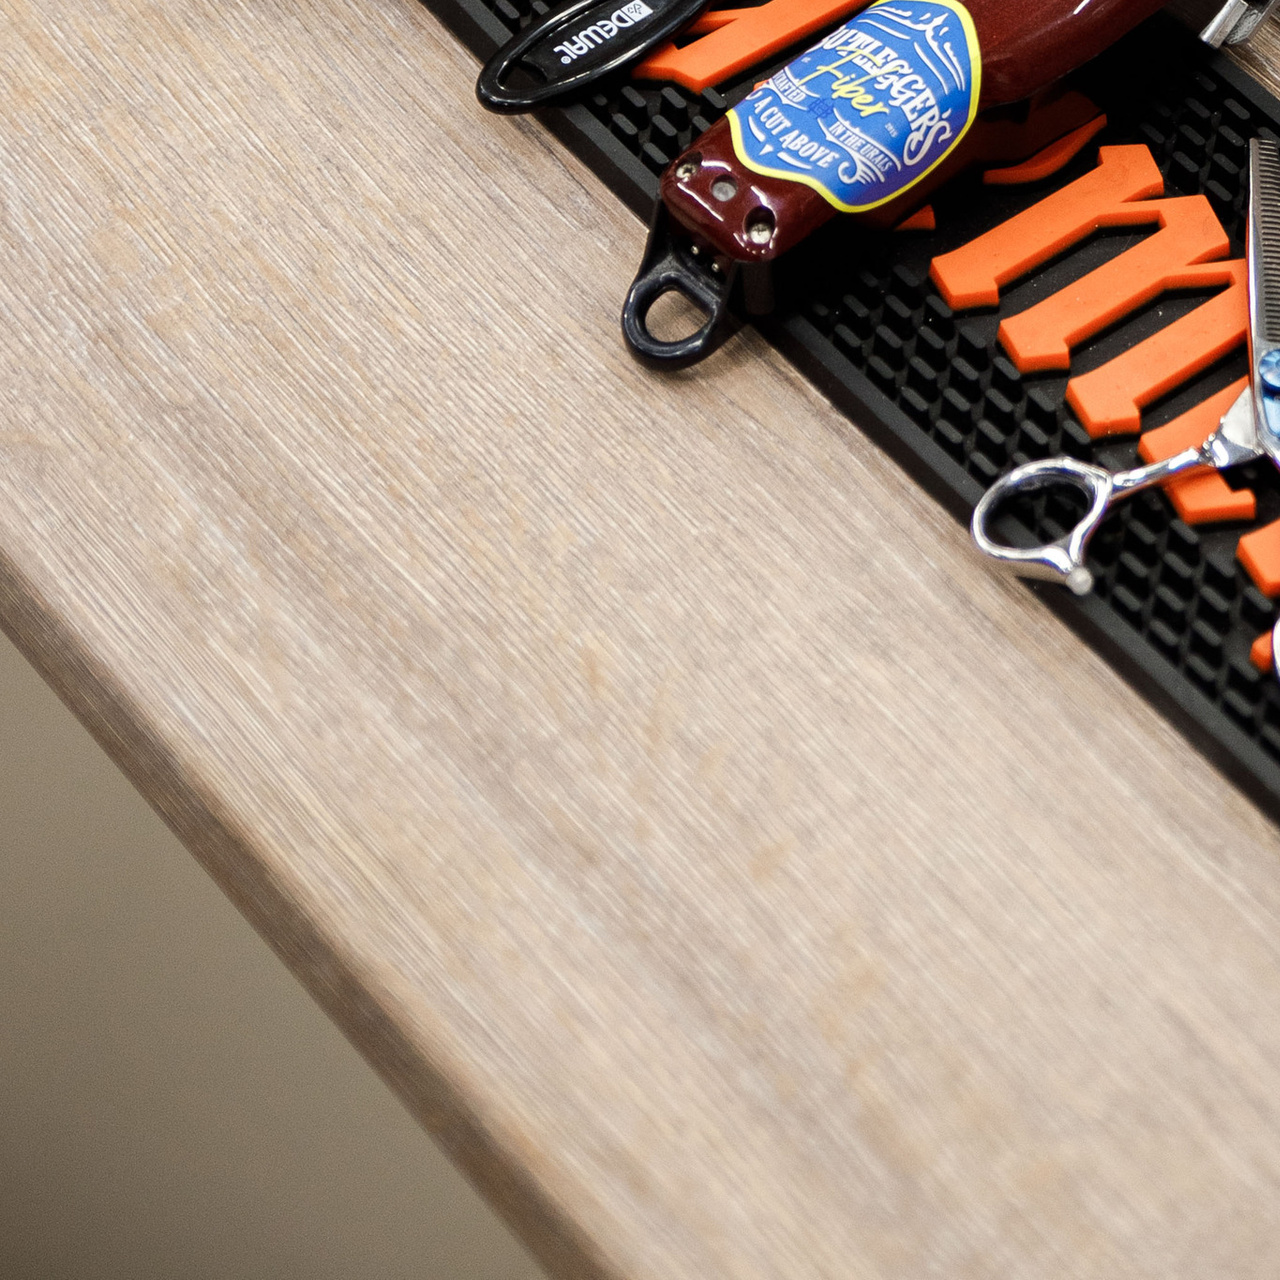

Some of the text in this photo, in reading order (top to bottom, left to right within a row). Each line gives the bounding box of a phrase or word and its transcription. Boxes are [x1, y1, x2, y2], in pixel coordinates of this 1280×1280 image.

[552, 9, 636, 60] DEWAL
[772, 69, 806, 103] CRAFTED
[797, 45, 899, 118] Fiber
[806, 26, 952, 166] UTLEGGER'S
[753, 95, 773, 115] A
[760, 106, 792, 136] CUT
[779, 129, 840, 168] ABOVE
[828, 121, 893, 172] IN THE URALS
